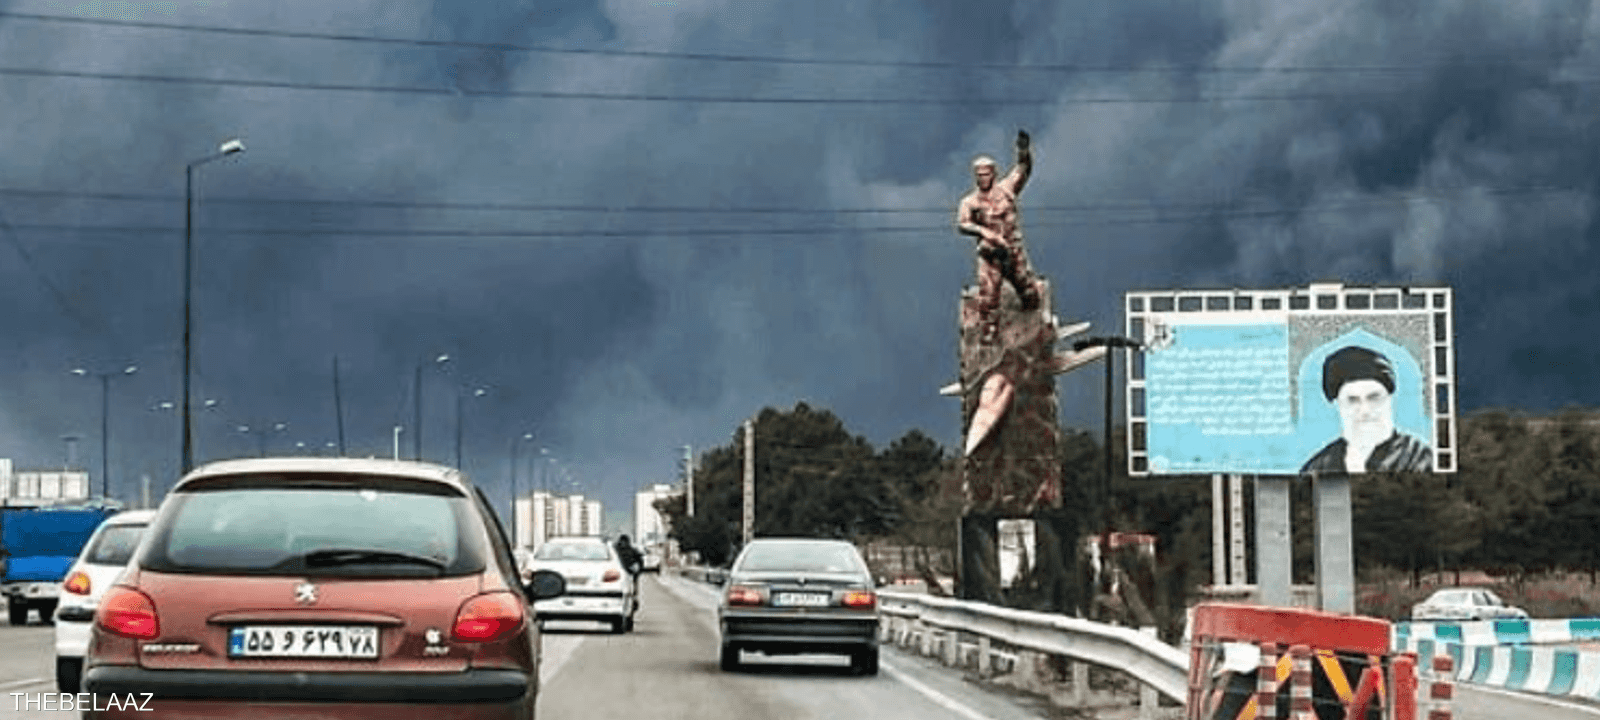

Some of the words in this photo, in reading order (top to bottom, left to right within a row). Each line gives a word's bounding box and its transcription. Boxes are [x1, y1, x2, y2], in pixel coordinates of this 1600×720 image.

[248, 631, 275, 651] ۵۵
[302, 630, 344, 653] ۶۲۹
[349, 635, 375, 653] ۷۸
